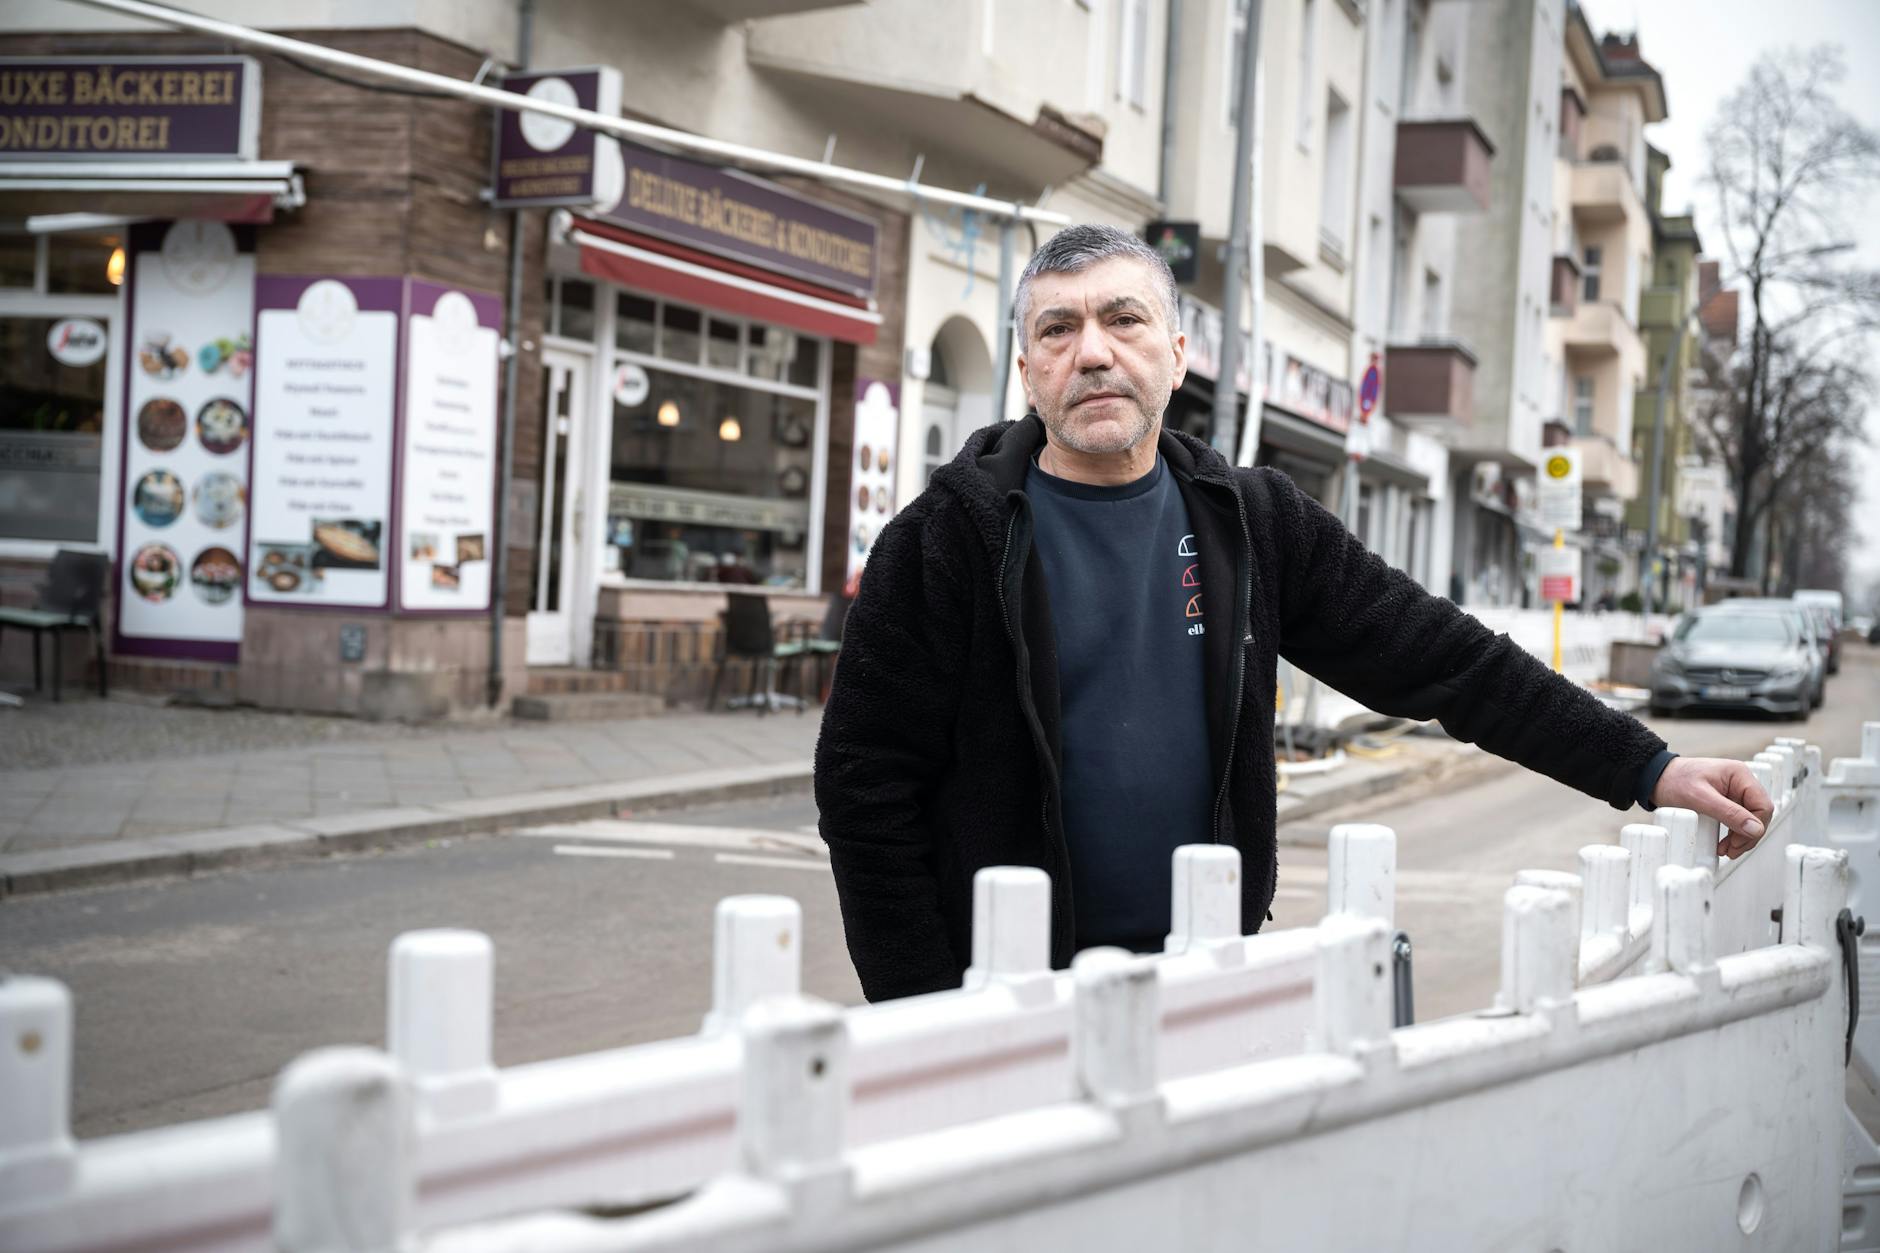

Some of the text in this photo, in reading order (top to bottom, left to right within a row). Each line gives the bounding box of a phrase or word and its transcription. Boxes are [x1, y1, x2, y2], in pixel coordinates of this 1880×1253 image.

[73, 66, 235, 105] BÄCKEREI
[629, 167, 696, 226] DELUXE
[699, 186, 775, 247] BÄCKEREI
[1187, 623, 1205, 636] ell
